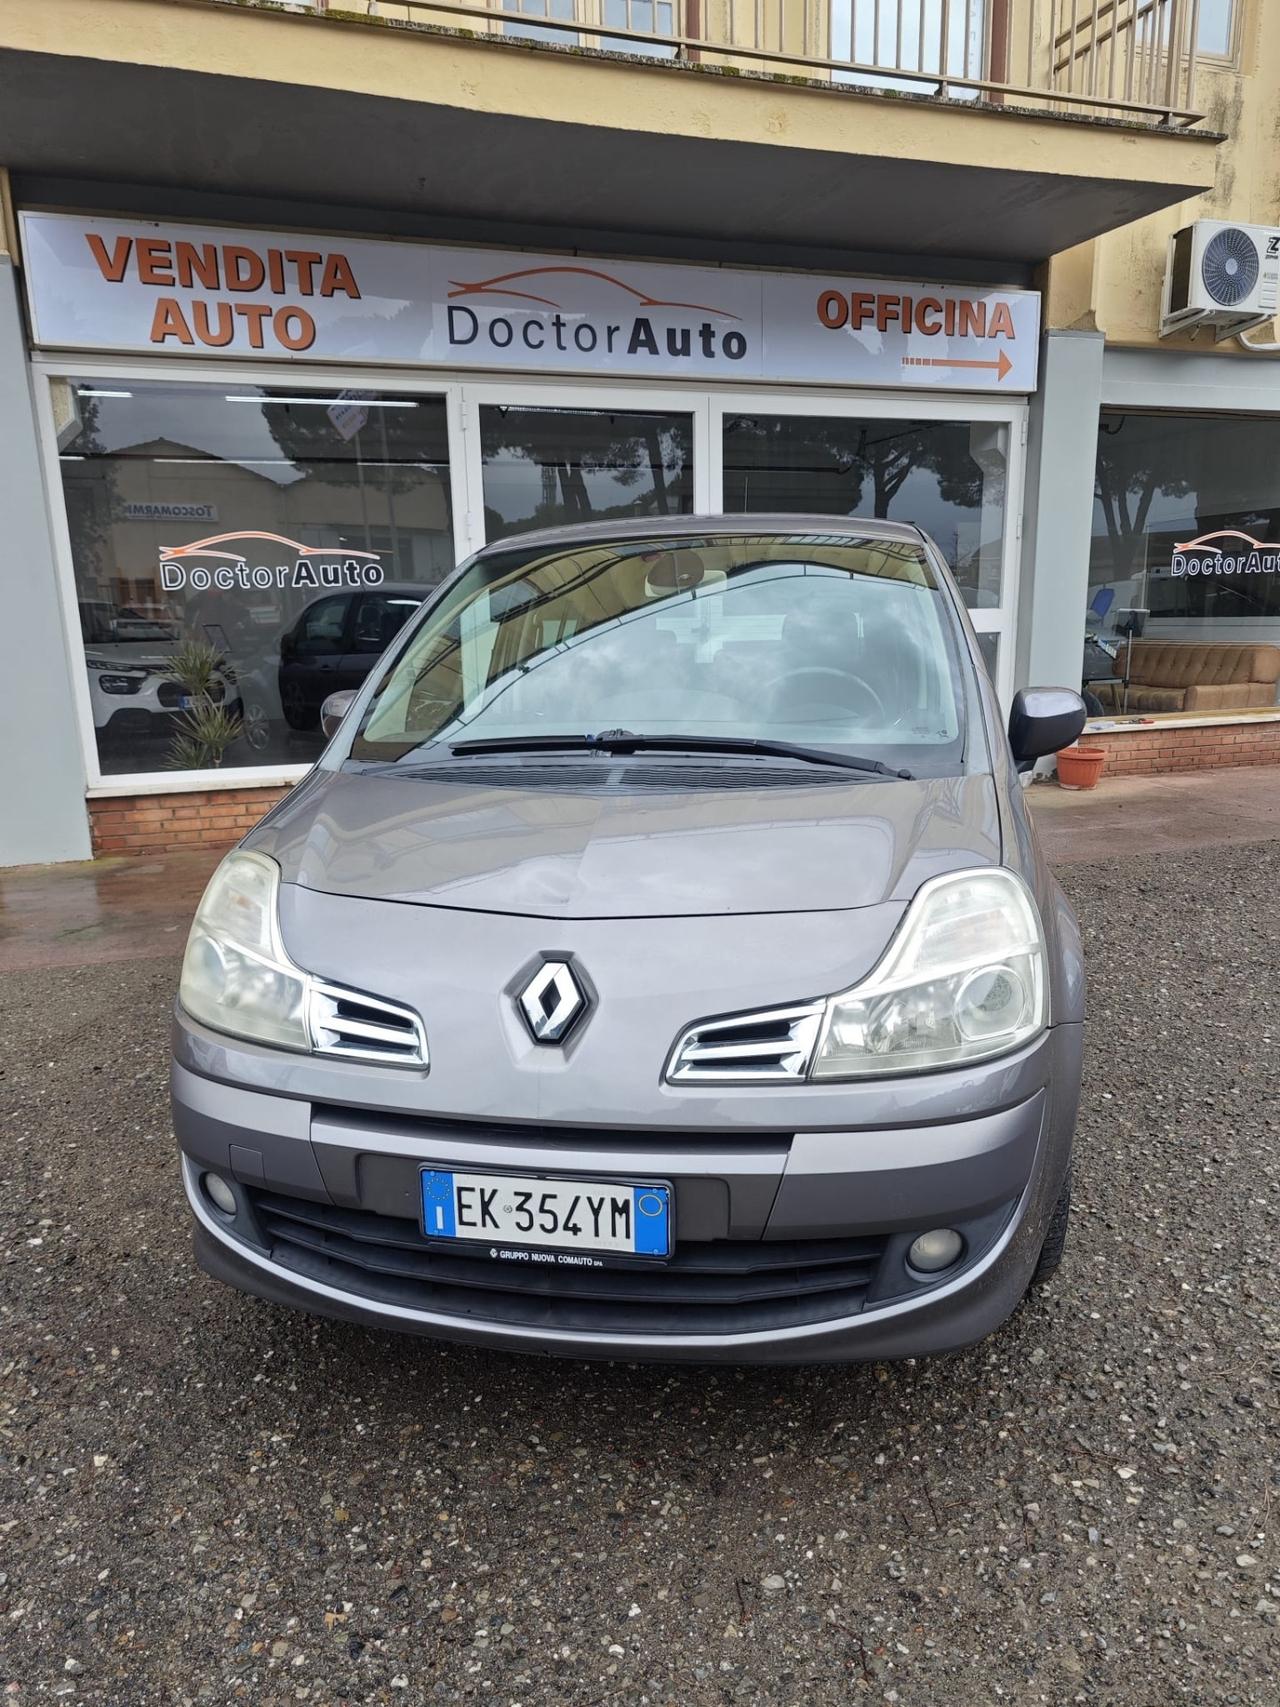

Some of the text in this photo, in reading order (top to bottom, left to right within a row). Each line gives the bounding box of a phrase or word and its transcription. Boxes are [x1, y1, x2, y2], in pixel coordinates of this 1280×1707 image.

[85, 233, 361, 299] VENDITA
[150, 297, 316, 351] AUTO
[447, 305, 747, 360] DoctorAuto
[816, 289, 1016, 340] OFFICINA
[159, 559, 384, 591] DoctorAuto
[456, 1186, 500, 1229] EK
[513, 1191, 631, 1240] 354YM
[500, 1250, 529, 1260] GRUPPO
[531, 1253, 556, 1263] NUOVA
[558, 1255, 593, 1266] COMAUTO
